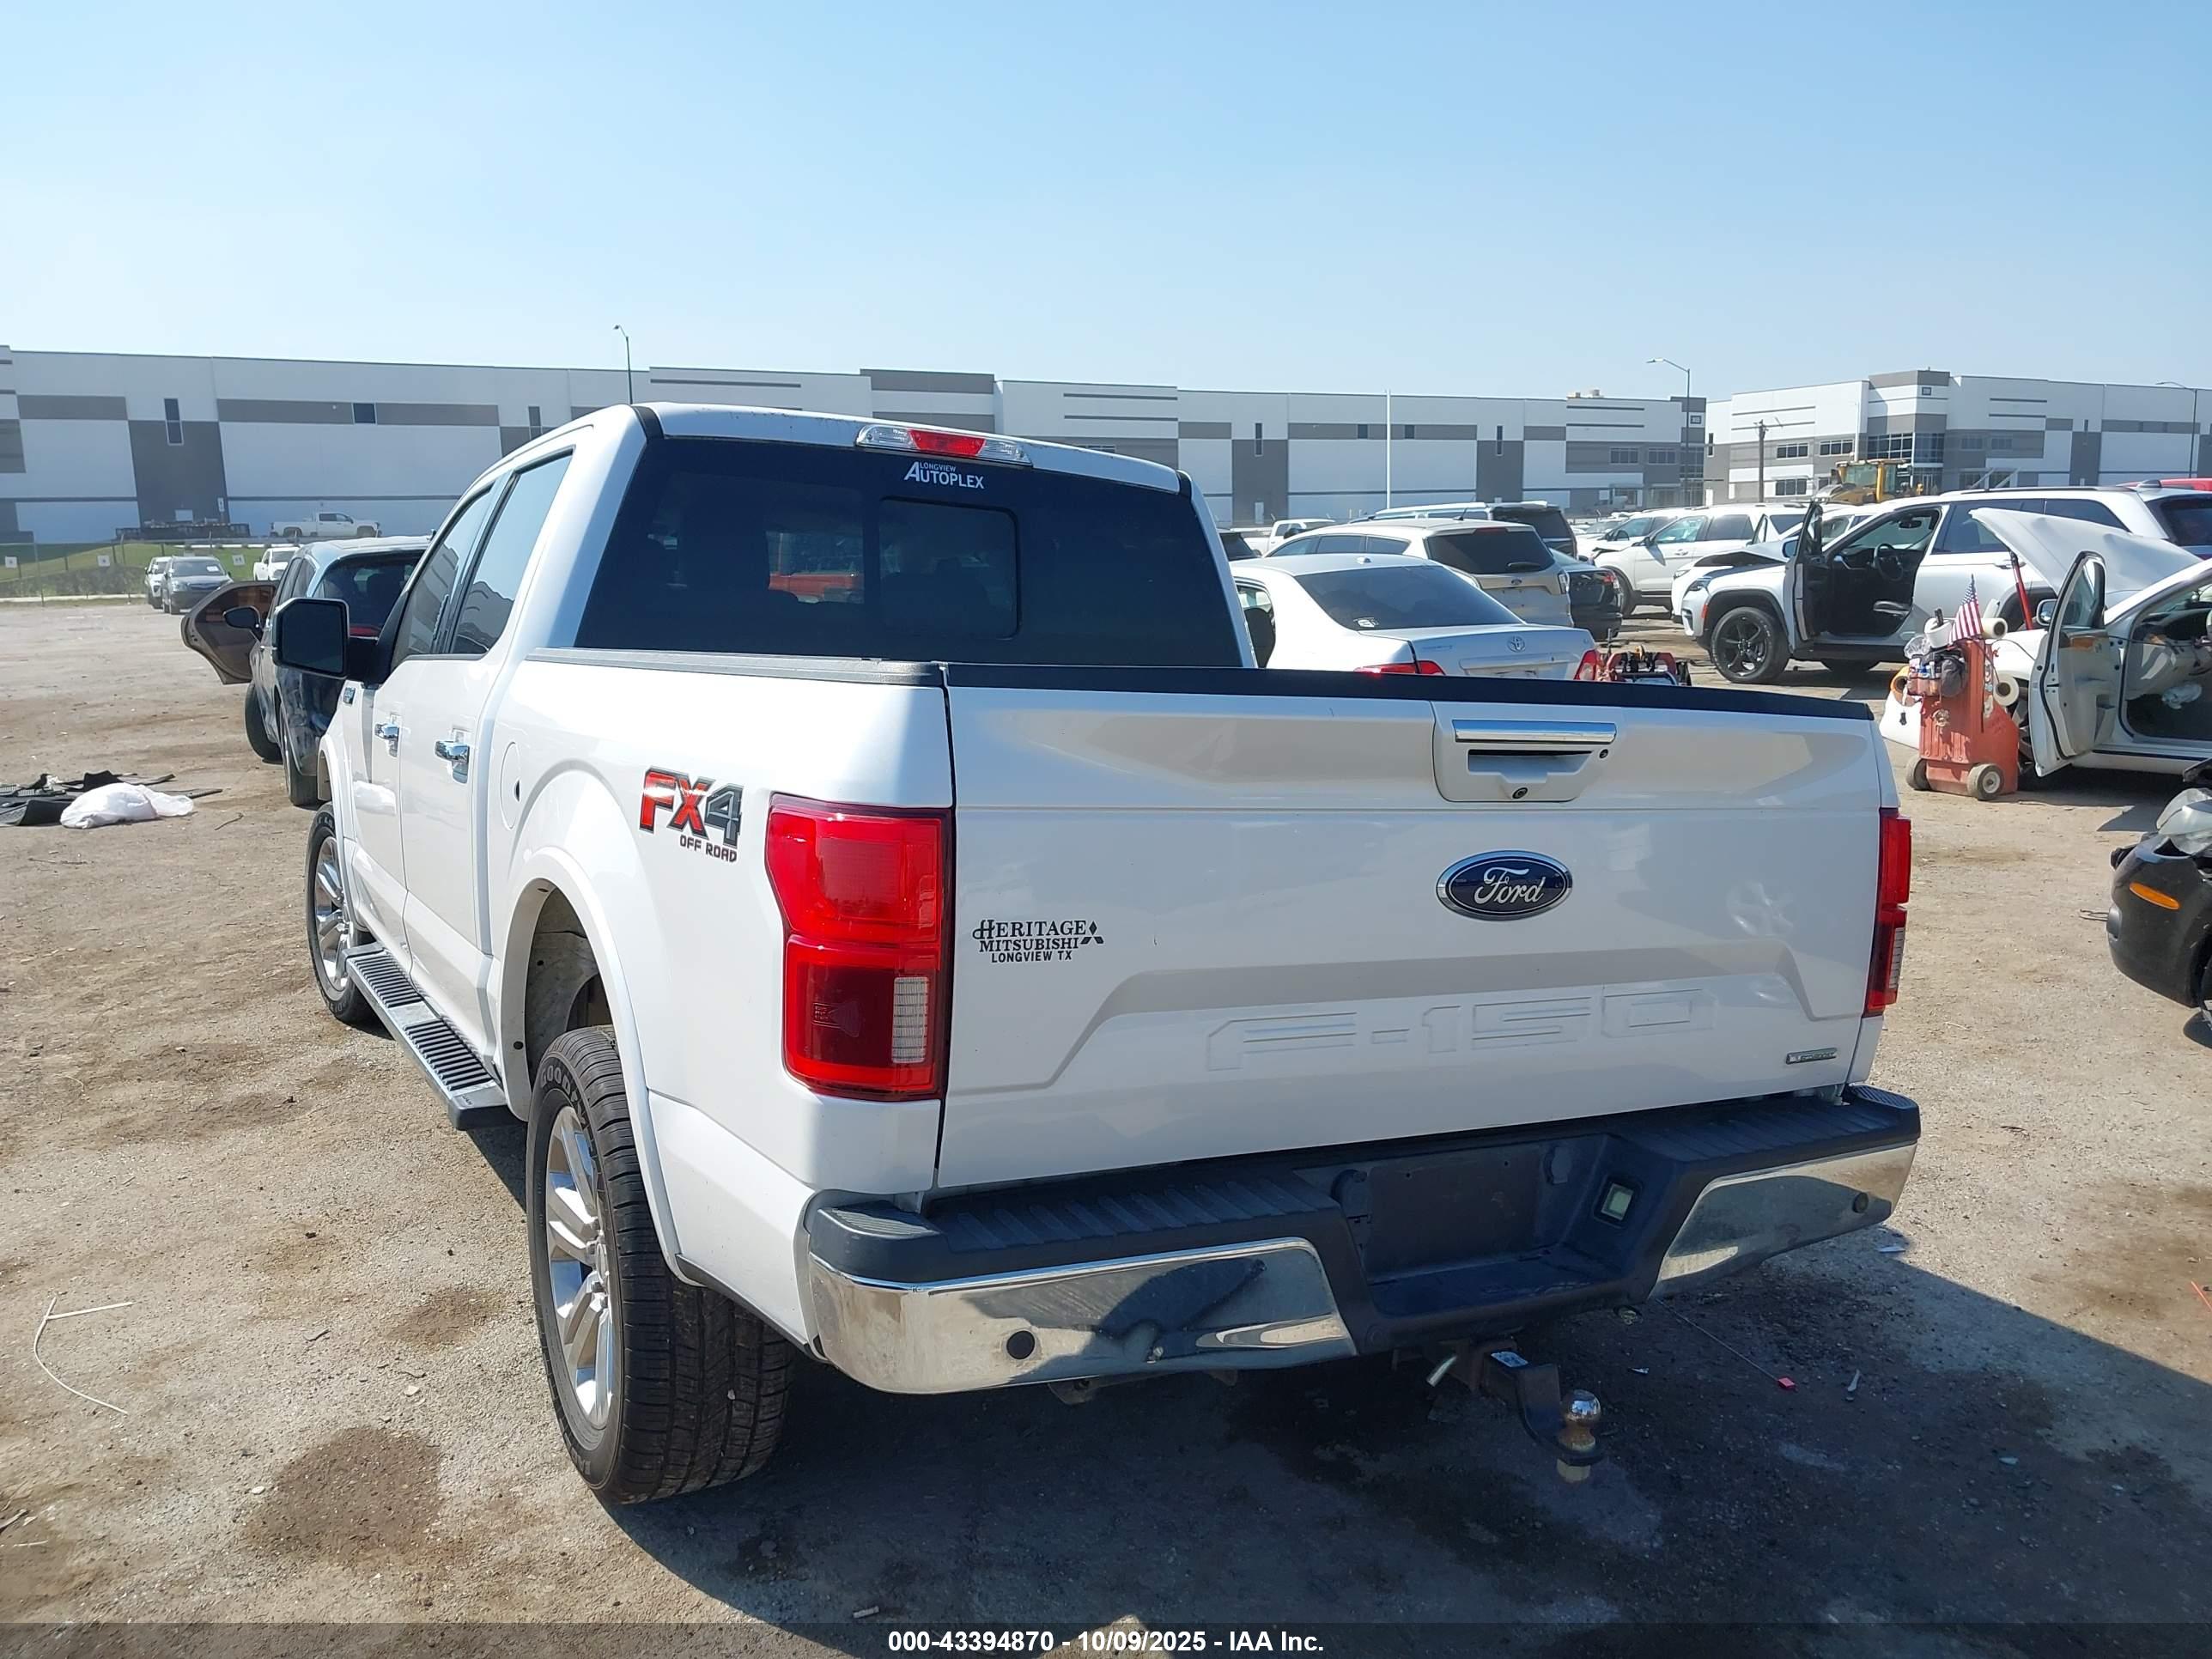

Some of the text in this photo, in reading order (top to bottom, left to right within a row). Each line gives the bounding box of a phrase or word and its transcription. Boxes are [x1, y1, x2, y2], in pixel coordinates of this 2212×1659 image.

[903, 461, 985, 489] AUTOPLEX
[920, 461, 956, 472] LONGVIEW
[639, 765, 744, 849] FX4
[679, 835, 738, 863] OFF ROAD
[1474, 866, 1547, 904] Ford
[972, 919, 1087, 940] HERITAGE
[979, 937, 1079, 953] MITSUBISHI
[991, 950, 1073, 963] LONGVIEW TX
